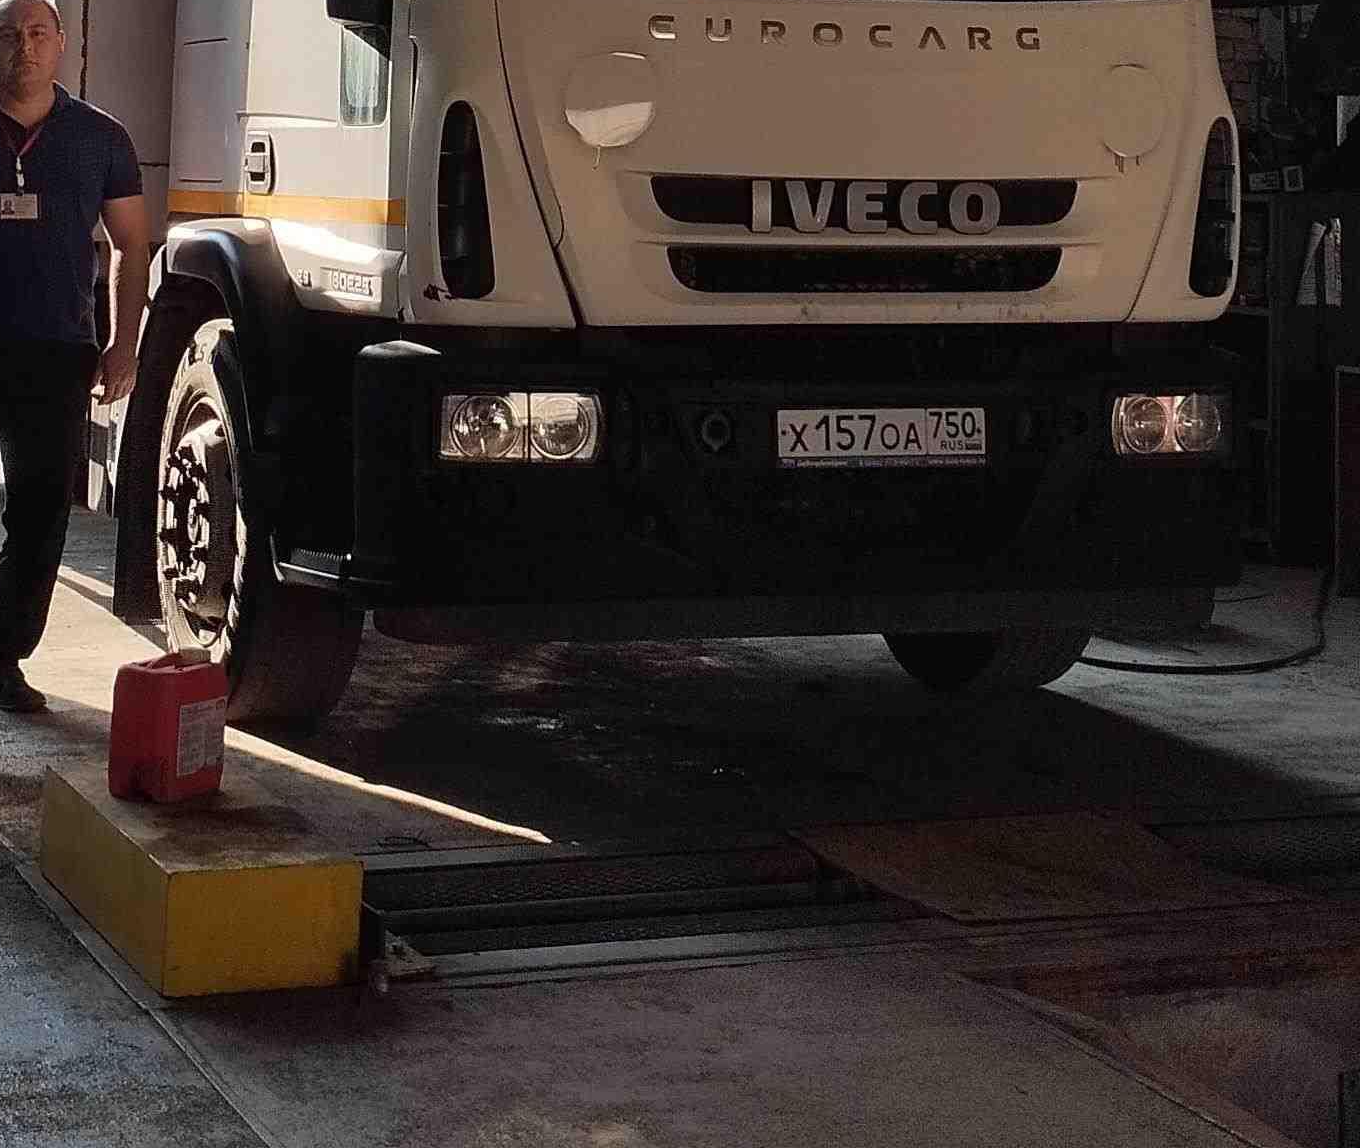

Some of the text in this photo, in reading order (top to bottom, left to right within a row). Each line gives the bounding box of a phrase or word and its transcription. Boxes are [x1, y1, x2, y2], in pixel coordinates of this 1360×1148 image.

[751, 179, 1002, 235] IVECO
[929, 411, 977, 439] 750
[940, 439, 965, 451] RUS
